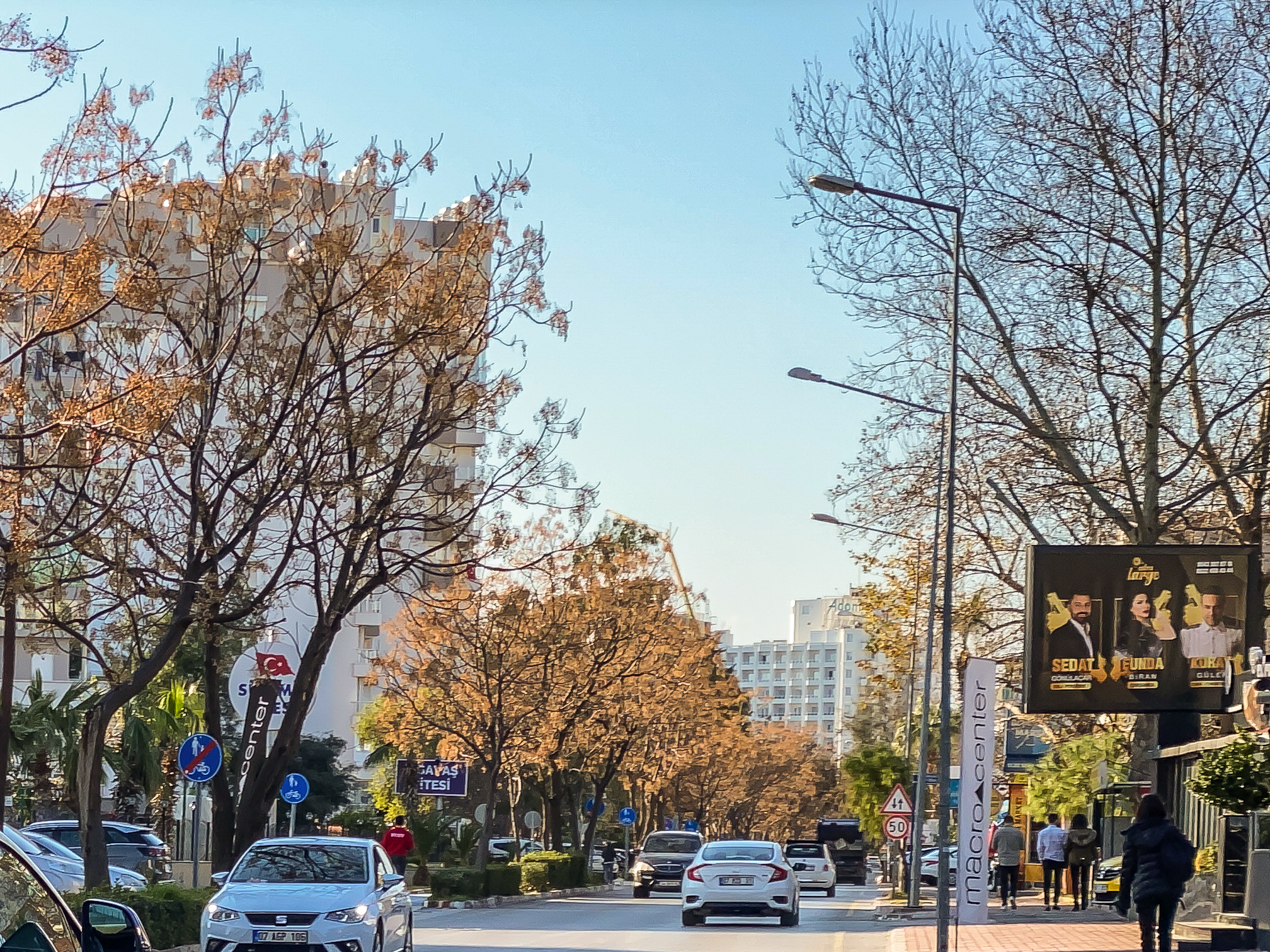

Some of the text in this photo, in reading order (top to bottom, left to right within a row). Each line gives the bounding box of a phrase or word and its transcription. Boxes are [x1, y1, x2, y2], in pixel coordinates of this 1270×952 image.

[1051, 657, 1095, 672] SEDAT
[1120, 657, 1165, 671] FUNDA
[240, 695, 270, 777] center
[971, 680, 987, 783] center
[419, 777, 451, 791] İTESİ
[889, 821, 905, 833] 50
